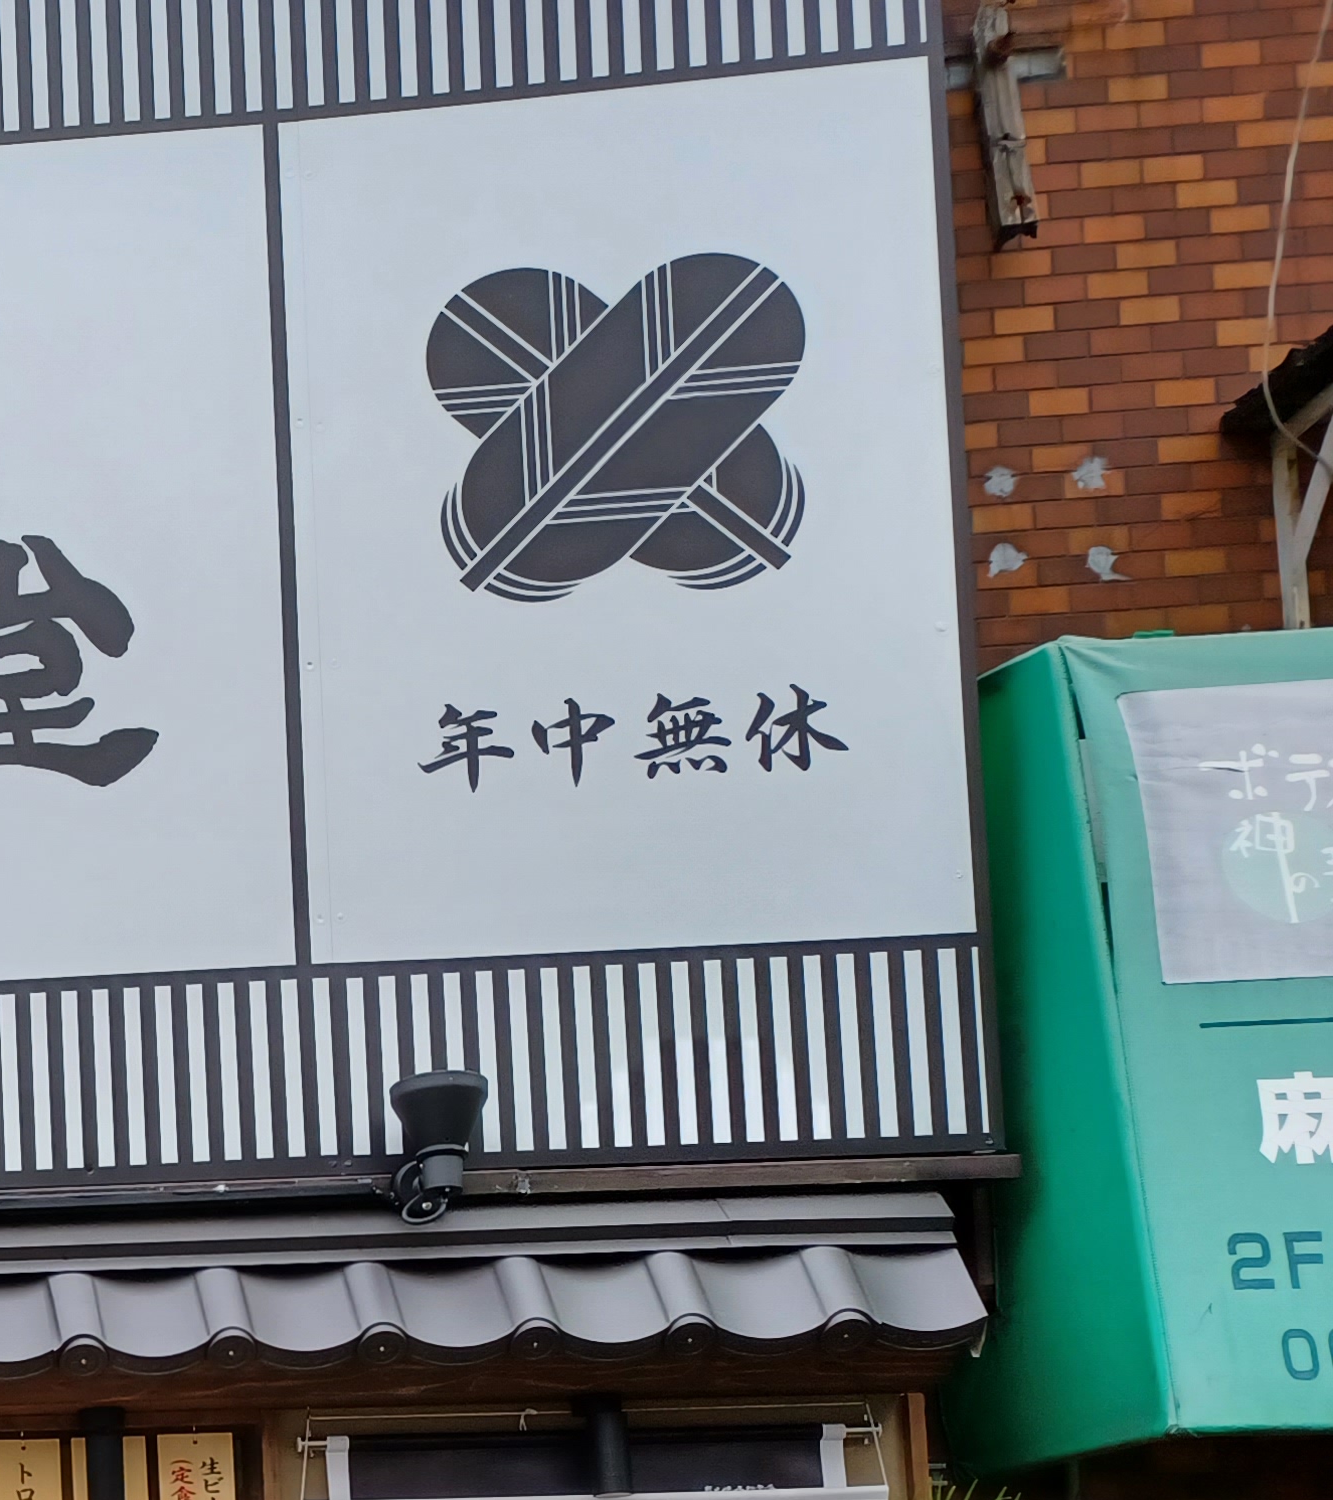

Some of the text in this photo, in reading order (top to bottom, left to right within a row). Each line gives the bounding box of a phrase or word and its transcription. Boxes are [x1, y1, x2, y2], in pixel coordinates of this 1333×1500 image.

[417, 684, 849, 793] 年中無休
[1227, 1231, 1324, 1289] 2F
